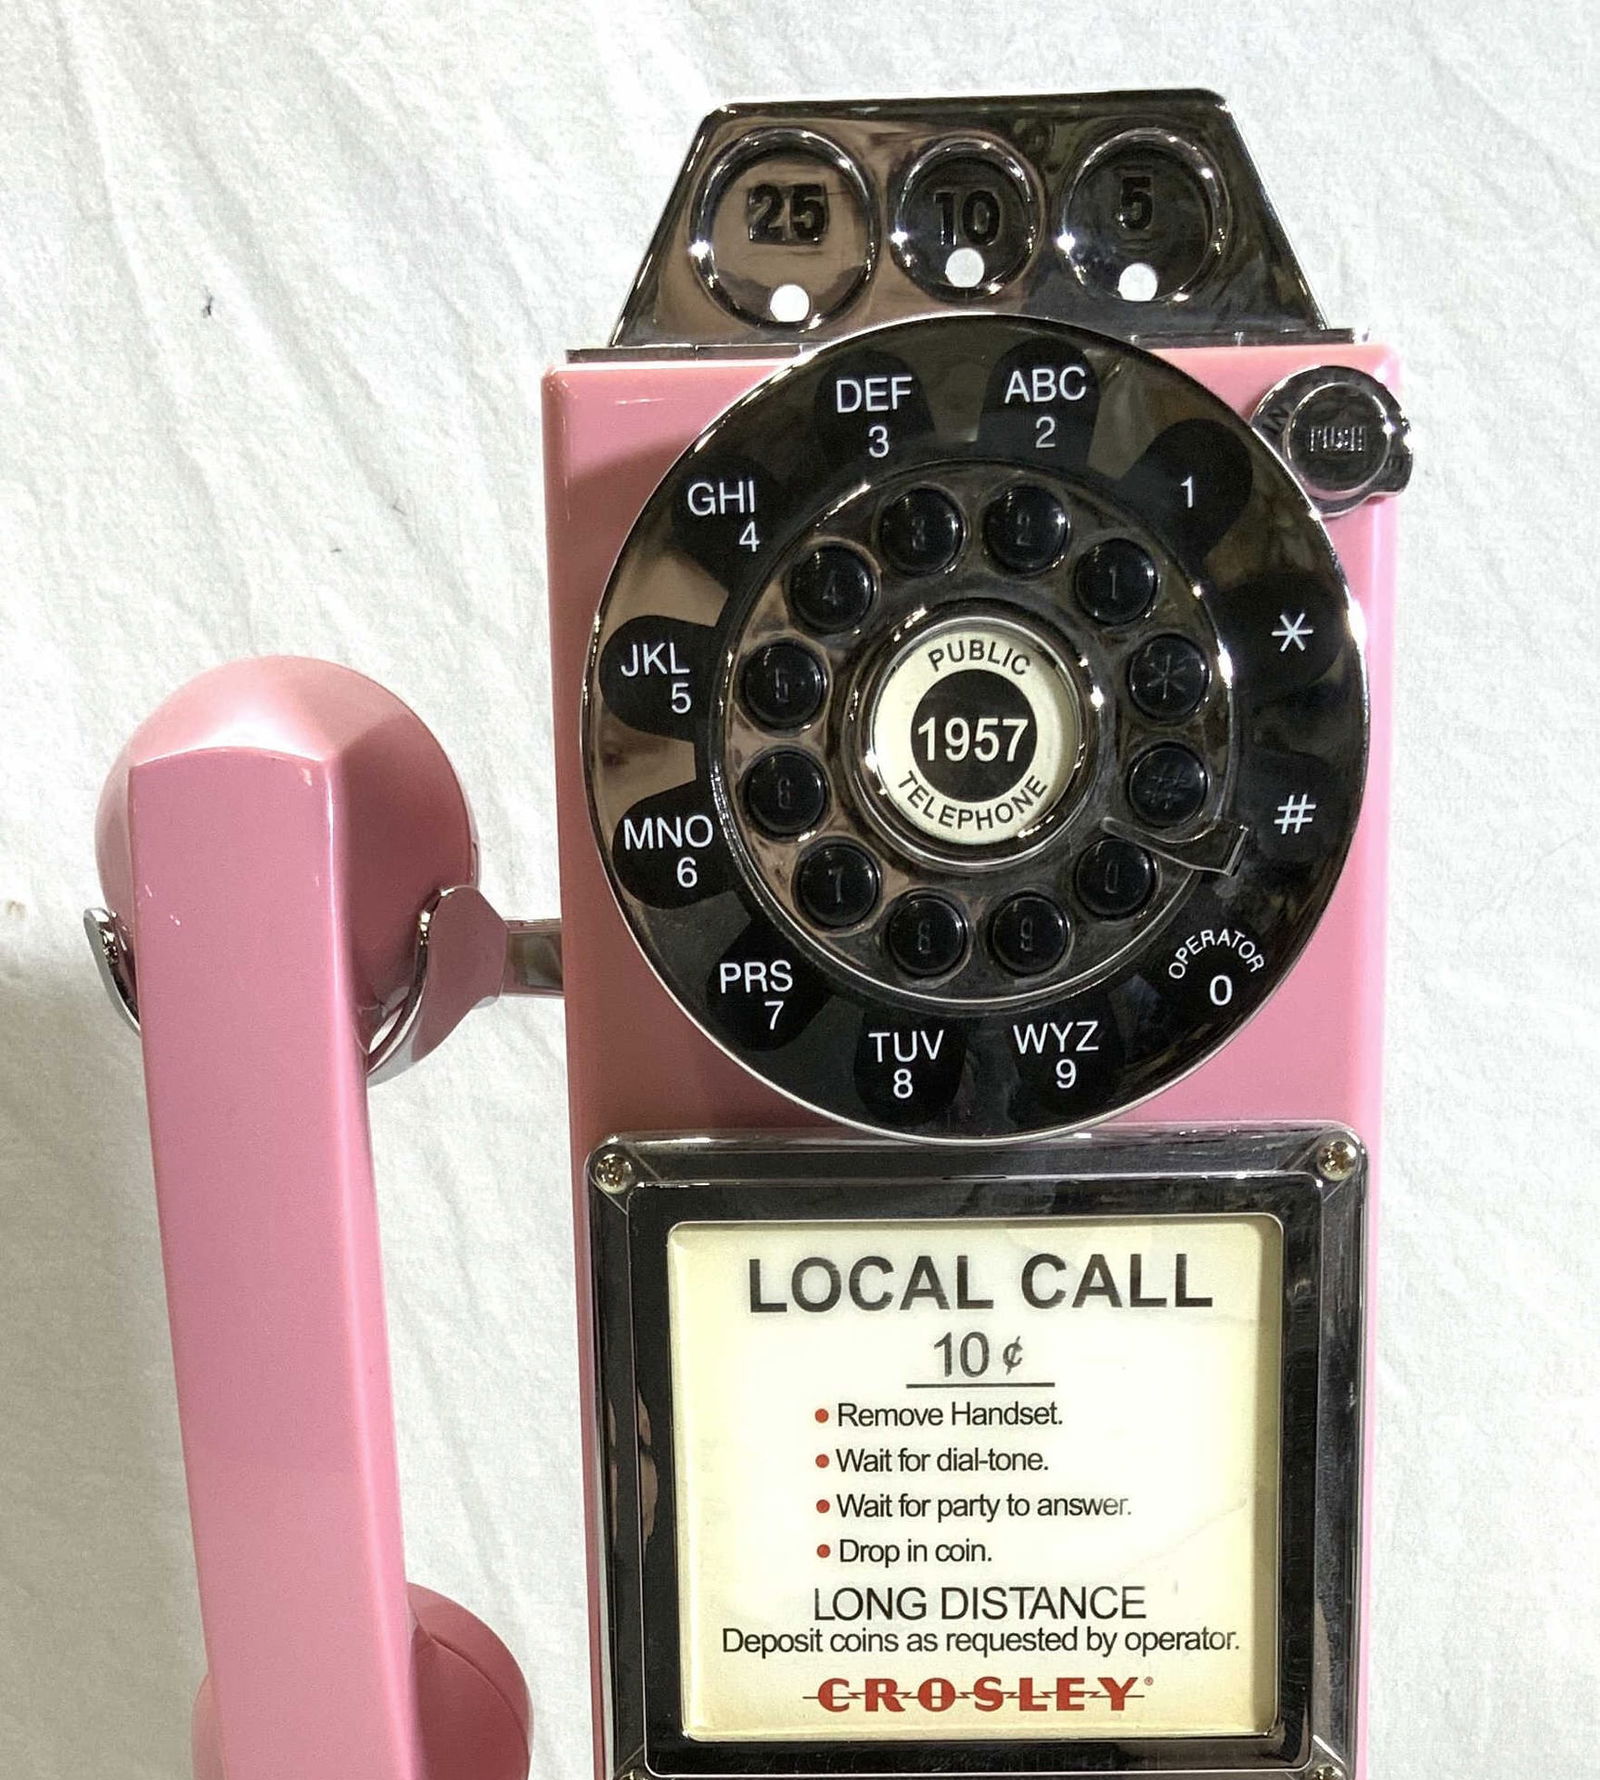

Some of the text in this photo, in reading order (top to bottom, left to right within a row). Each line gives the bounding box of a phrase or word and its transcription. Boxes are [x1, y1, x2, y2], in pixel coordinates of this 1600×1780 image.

[747, 181, 830, 246] 25
[934, 189, 1002, 248] 10
[1115, 174, 1154, 231] 5
[835, 375, 913, 414] DEF
[1004, 365, 1088, 404] ABC
[867, 425, 890, 459] 3
[1034, 415, 1057, 449] 2
[686, 479, 757, 516] GHI
[1179, 475, 1195, 509] 1
[738, 520, 761, 553] 4
[620, 641, 691, 678] JKL
[927, 638, 1031, 677] PUBLIC
[670, 681, 692, 715] 5
[917, 716, 1029, 763] 1957
[897, 769, 1049, 832] TELEPHONE
[623, 813, 715, 851] MNO
[675, 855, 699, 889] 6
[1167, 927, 1266, 981] OPERATOR
[718, 958, 794, 995] PRS
[1208, 974, 1234, 1007] 0
[764, 999, 785, 1031] 7
[868, 1028, 945, 1065] TUV
[1012, 1019, 1100, 1056] WYZ
[892, 1067, 914, 1100] 8
[1054, 1057, 1077, 1090] 9
[748, 1251, 1214, 1314] LOCAL CALL
[837, 1400, 1065, 1427] Remove Handset.
[836, 1446, 1050, 1473] Wait for dial-tone.
[836, 1494, 1133, 1523] Wait for party to answer.
[839, 1539, 993, 1567] Drop in coin.
[813, 1585, 1148, 1622] LONG DISTANCE
[722, 1626, 1242, 1659] Deposit coins as requested by operator.
